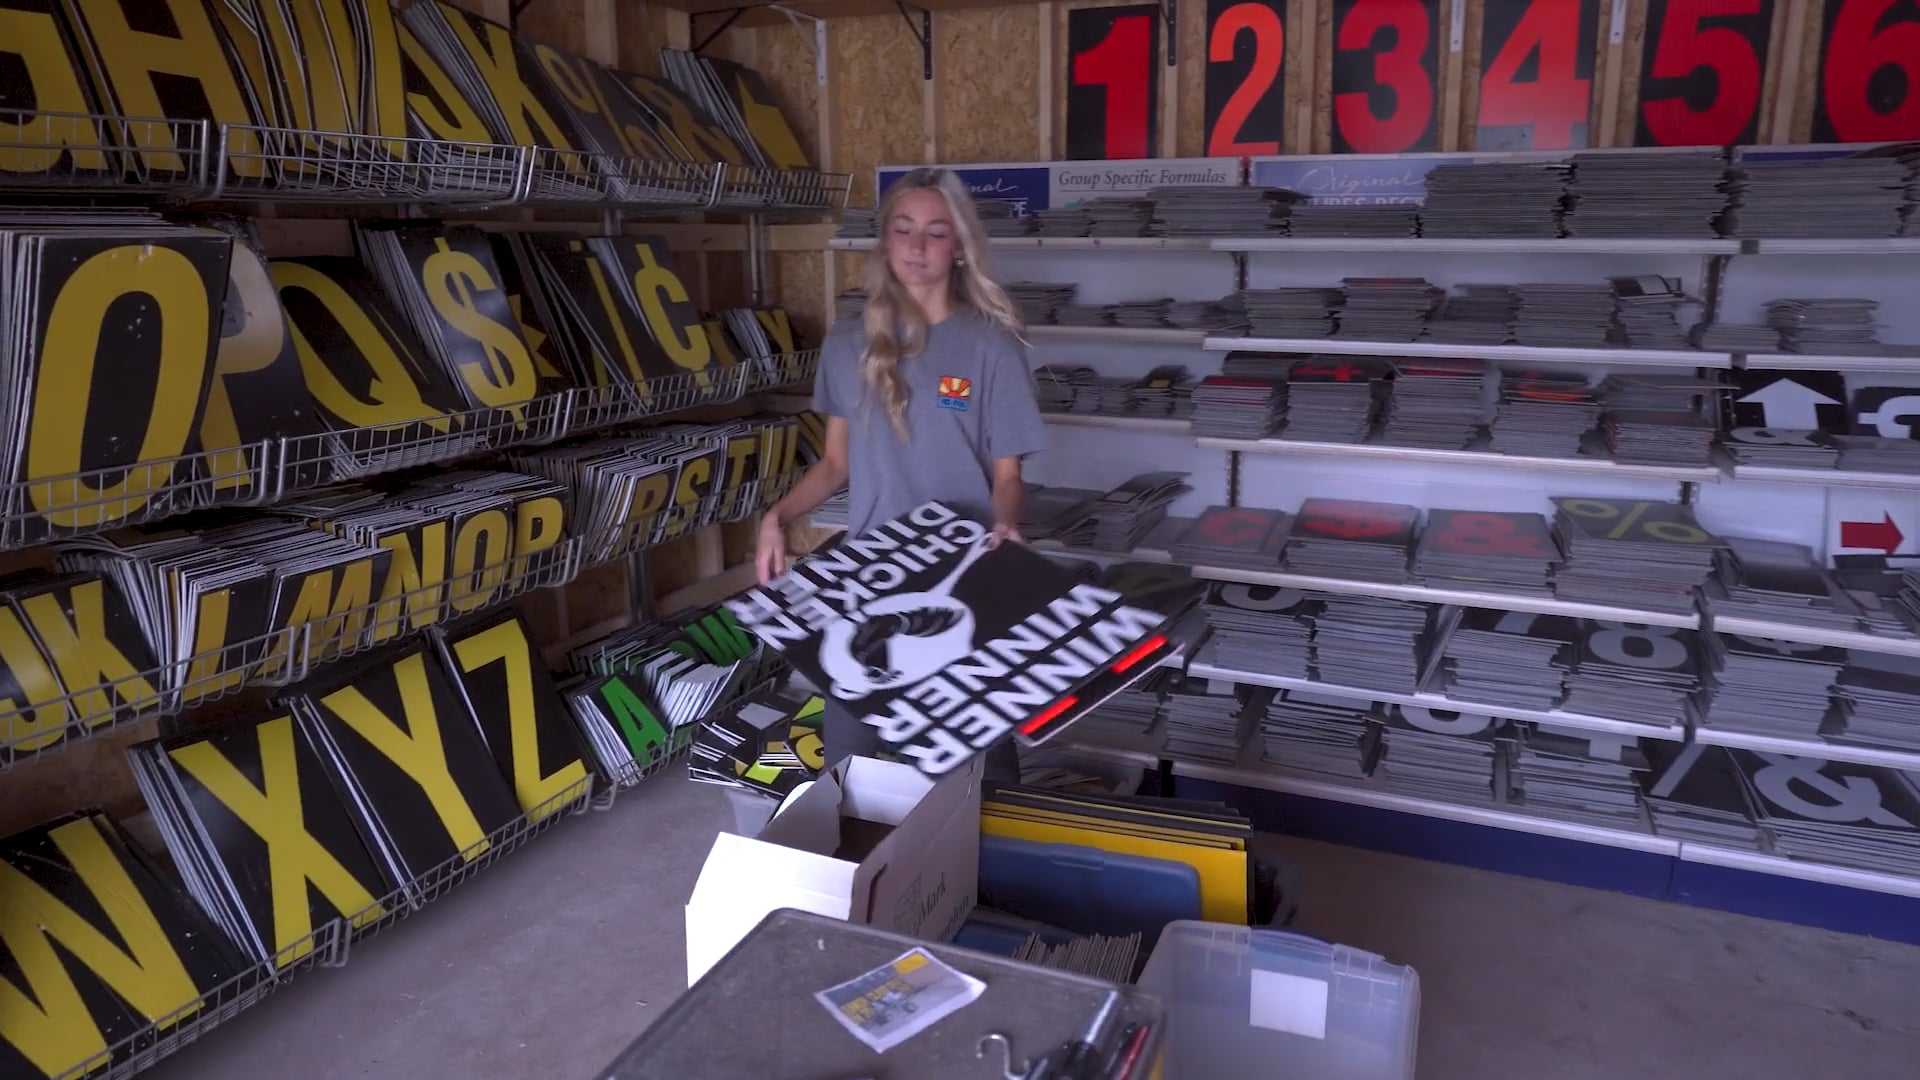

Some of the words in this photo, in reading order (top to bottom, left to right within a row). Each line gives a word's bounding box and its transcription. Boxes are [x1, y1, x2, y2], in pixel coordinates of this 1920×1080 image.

[1074, 15, 1151, 159] 1
[1208, 2, 1284, 157] 2
[1333, 0, 1433, 154] 3
[1479, 0, 1591, 149] 4
[1642, 0, 1760, 146] 5
[1824, 0, 1920, 143] 6
[1059, 170, 1100, 189] Group
[1104, 169, 1156, 188] Specific
[1159, 168, 1227, 184] Formulas
[423, 237, 537, 431] $
[507, 497, 563, 590] P
[664, 458, 711, 535] S
[720, 438, 757, 518] T
[1561, 499, 1708, 543] %
[254, 559, 374, 676] M
[373, 521, 447, 642] N
[722, 500, 962, 626] DINNER
[750, 519, 988, 651] CHICKEN
[20, 579, 161, 728] K
[453, 618, 591, 823] Z
[601, 676, 669, 768] A
[862, 583, 1122, 743] WINNER
[900, 604, 1168, 775] WINNER
[322, 651, 491, 863] Y
[168, 715, 388, 968] X
